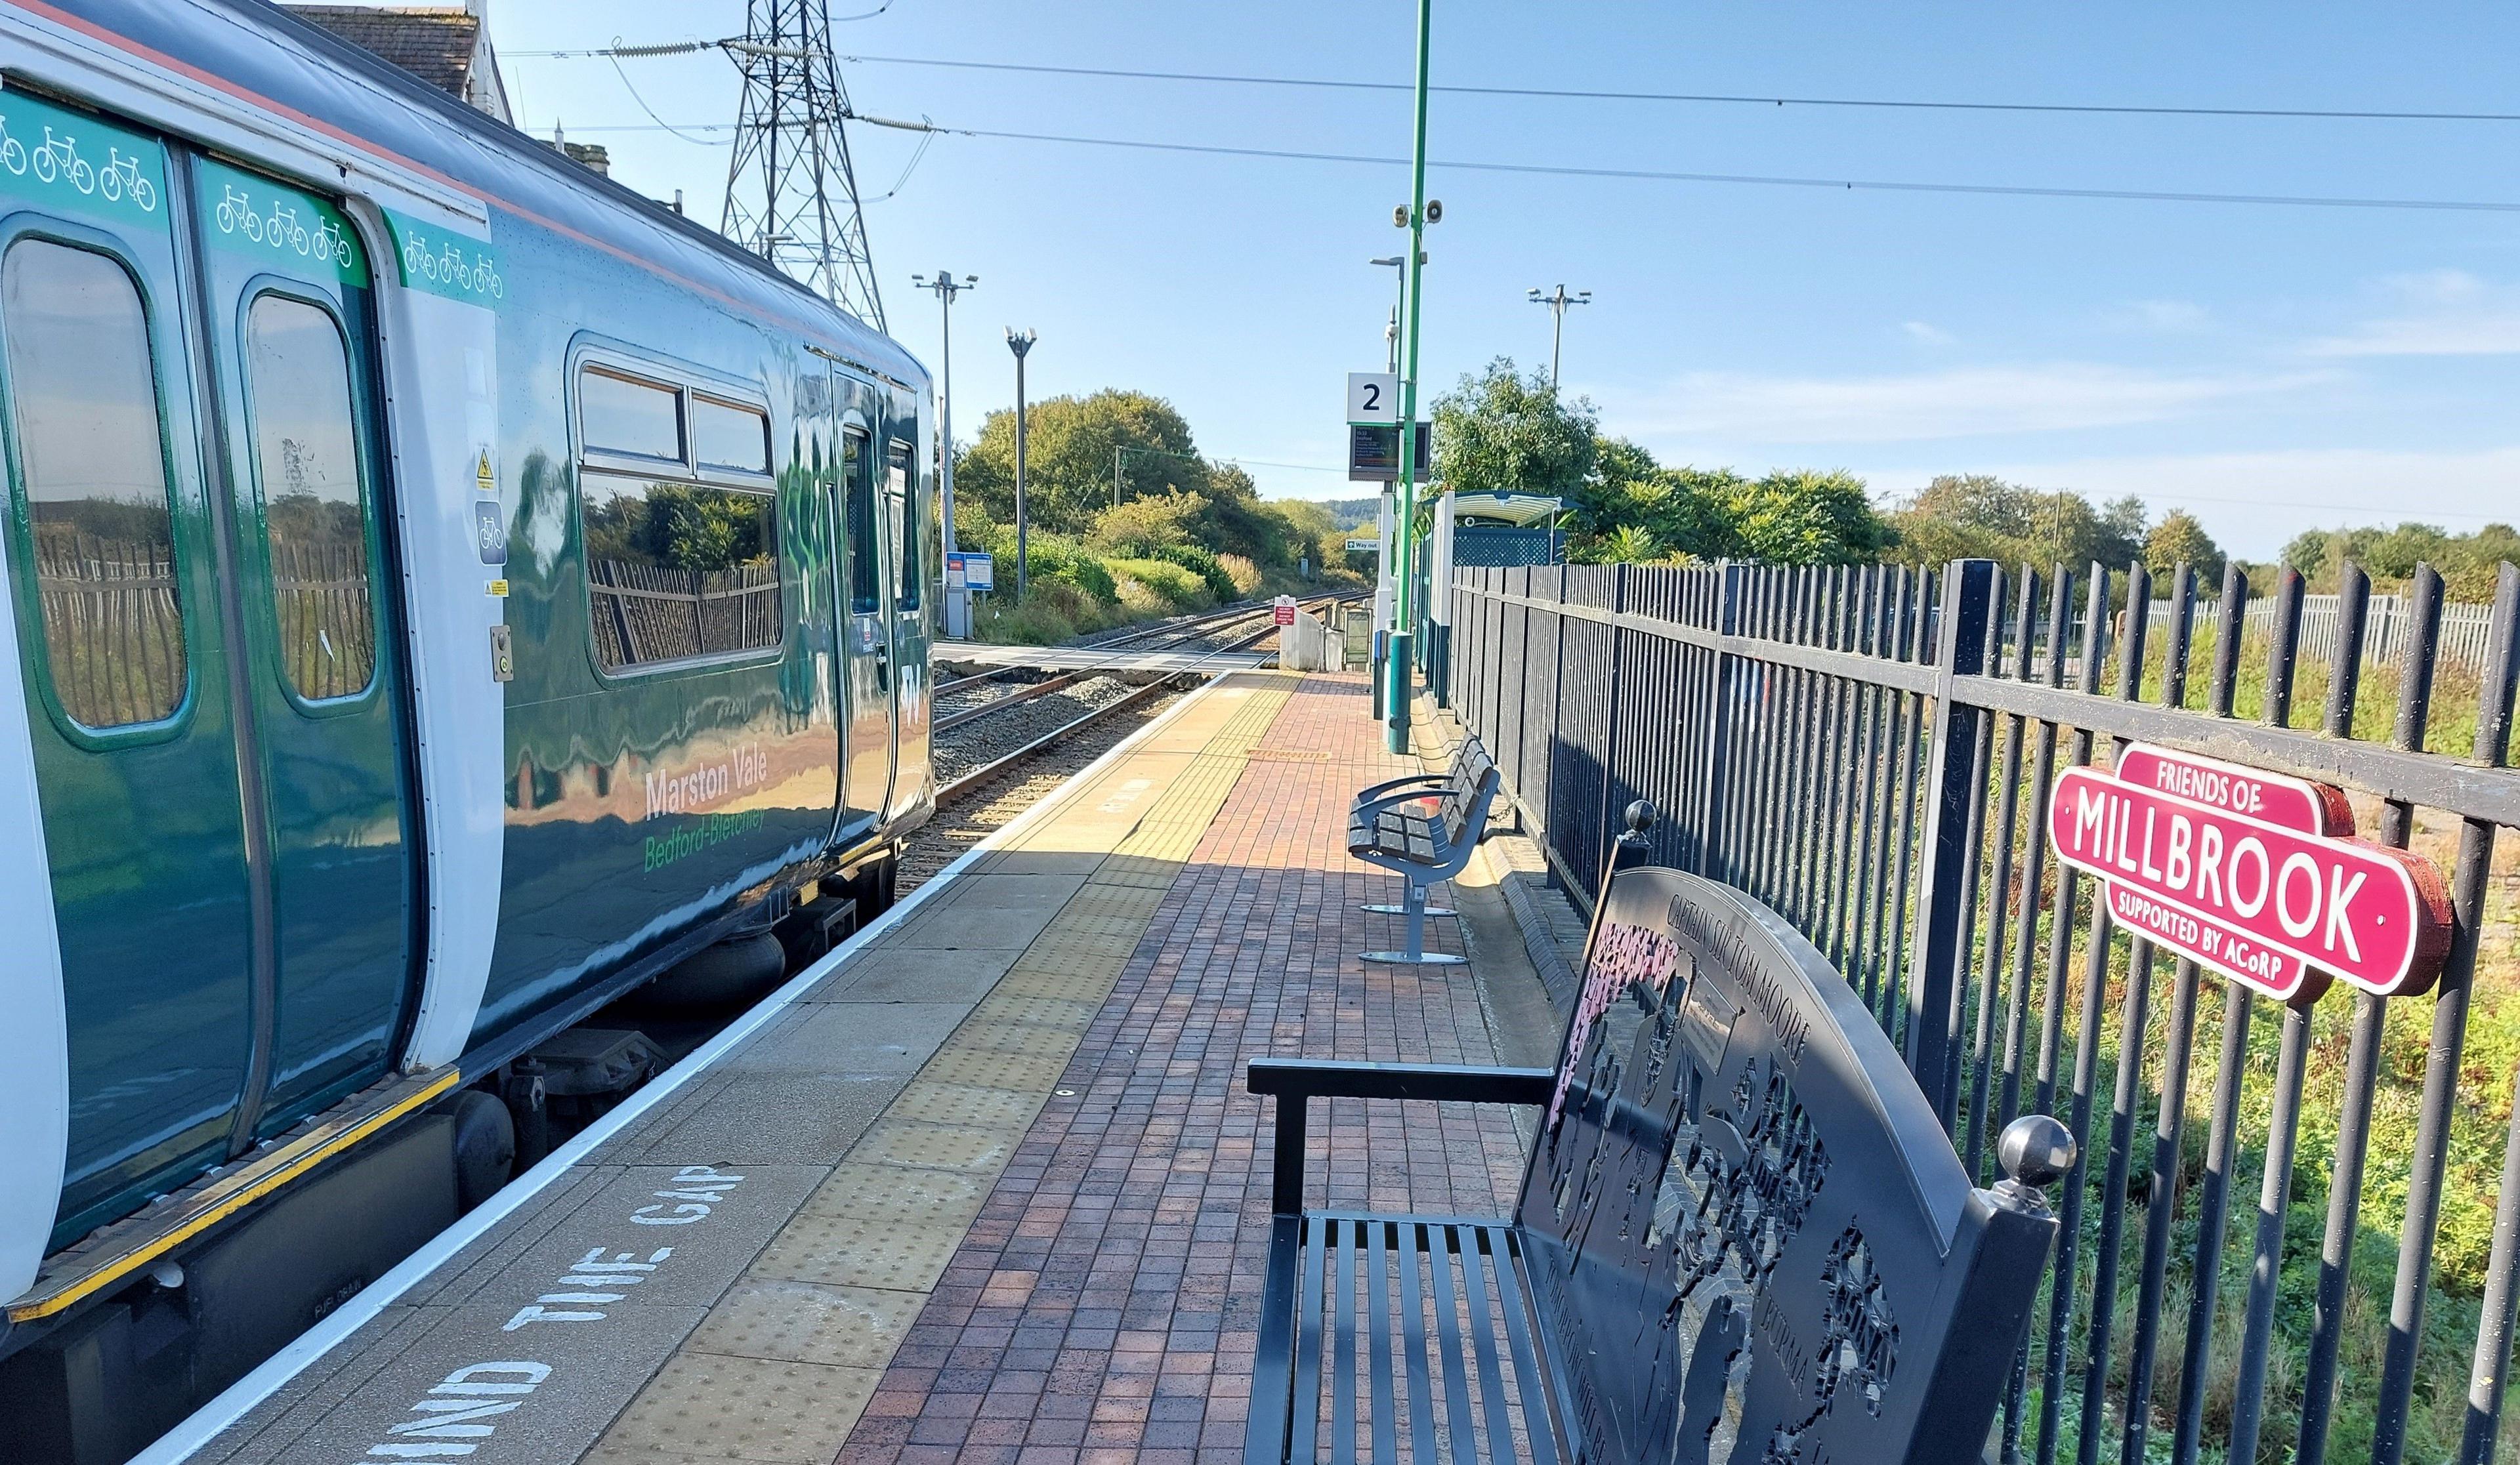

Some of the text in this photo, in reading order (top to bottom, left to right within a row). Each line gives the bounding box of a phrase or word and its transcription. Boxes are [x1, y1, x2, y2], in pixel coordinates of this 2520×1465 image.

[1362, 382, 1381, 411] 2
[645, 741, 767, 821] Marston Vale
[2155, 759, 2230, 807] FRIENDS
[644, 808, 766, 874] Bedford-Bletchley
[2073, 785, 2368, 964] MILLBROOK
[1666, 893, 1715, 948] CAPTAIN
[1708, 918, 1733, 968] SIR
[1727, 936, 1761, 999] TOM
[1754, 965, 1811, 1067] MOORE
[2118, 890, 2282, 982] SUPPORTED BY ACoRP
[352, 1165, 746, 1465] IND THE GAP
[1760, 1294, 1809, 1401] BURMA
